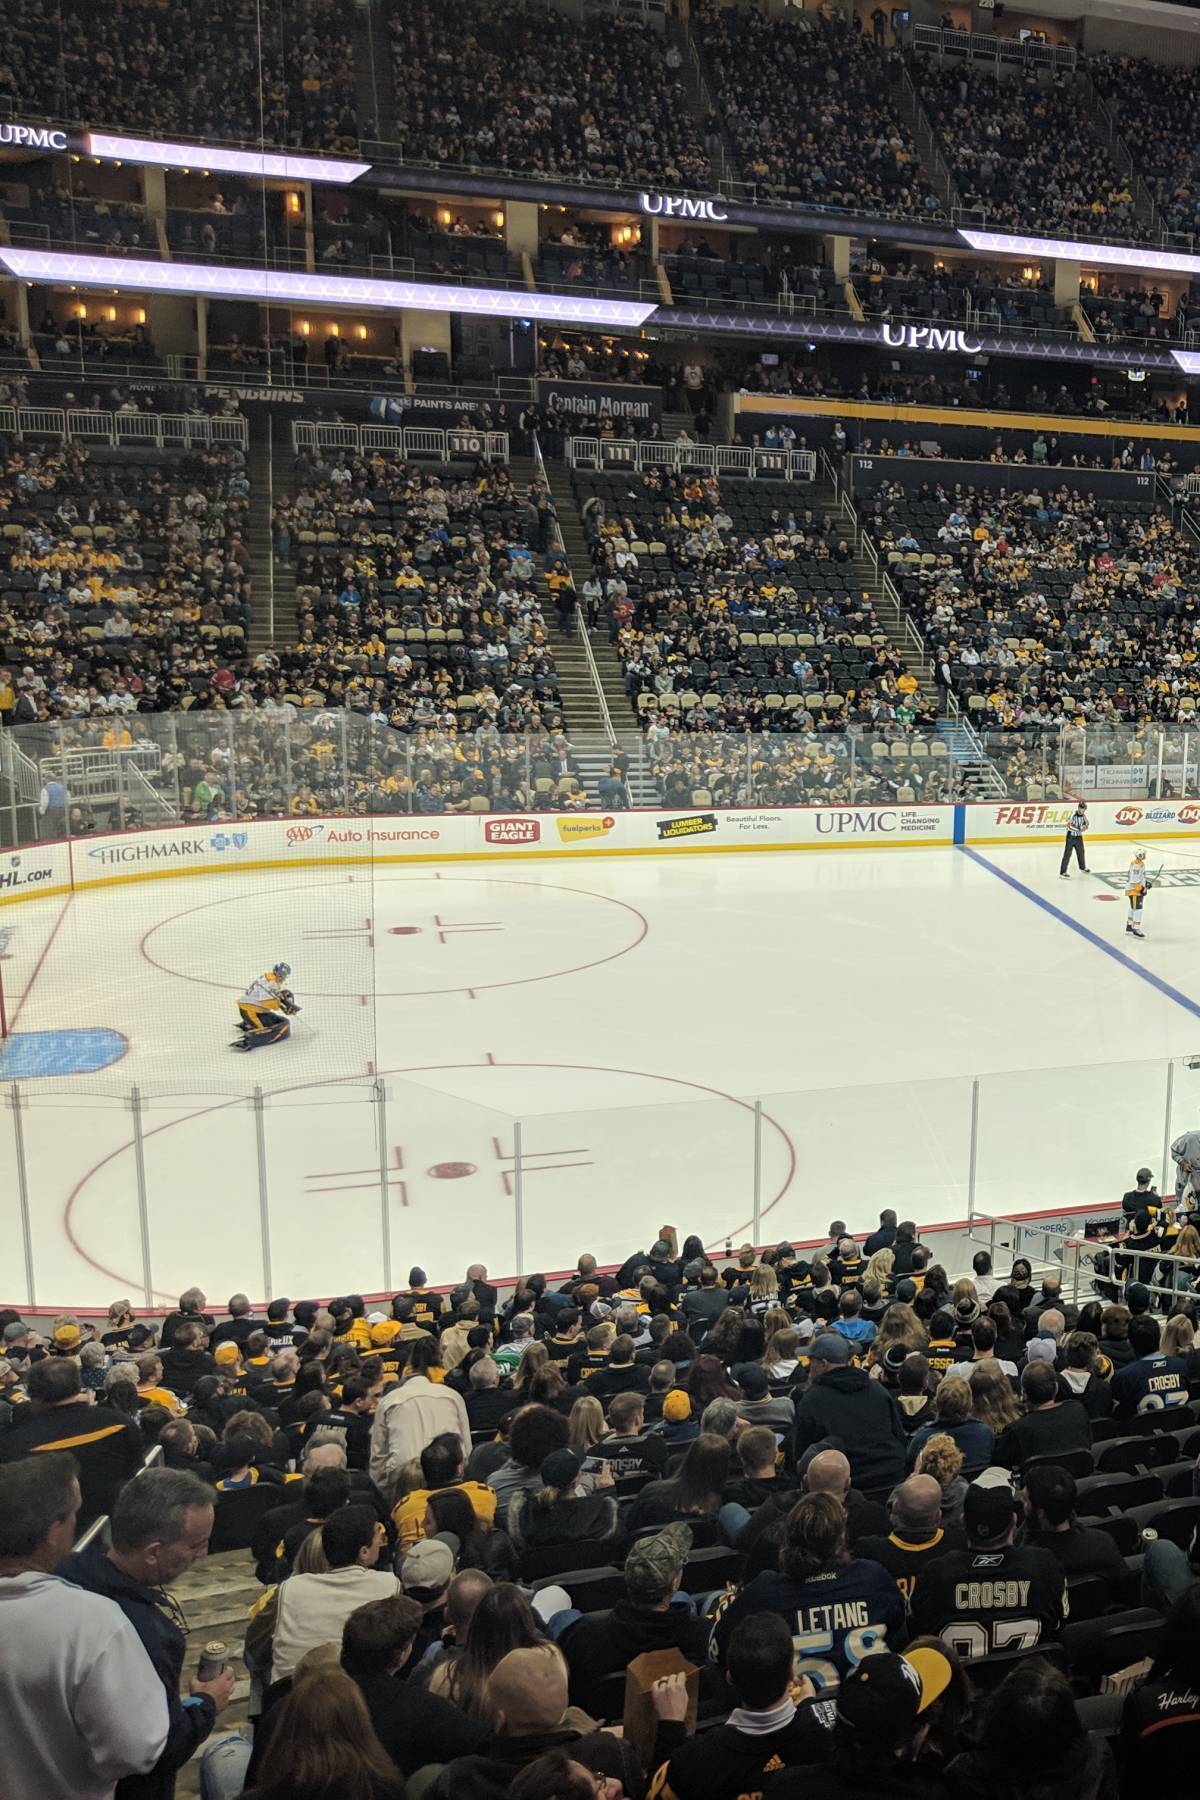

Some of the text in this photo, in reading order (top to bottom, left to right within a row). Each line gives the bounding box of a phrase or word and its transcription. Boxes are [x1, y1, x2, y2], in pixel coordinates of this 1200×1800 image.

[0, 124, 68, 150] UPMC
[643, 193, 729, 221] UPMC
[882, 324, 982, 353] UPMC
[413, 400, 451, 410] PAINTS
[453, 438, 480, 452] 110
[608, 447, 630, 460] 111
[761, 456, 782, 468] 111
[858, 460, 873, 470] 112
[1136, 477, 1150, 486] 112
[726, 815, 757, 823] Beautiful
[995, 806, 1071, 825] FAST PLA
[1119, 810, 1140, 822] DQ
[1145, 811, 1176, 820] BLIZZARD
[1182, 808, 1200, 820] DQ
[489, 822, 536, 832] GIANT
[671, 818, 704, 828] LUMBER
[815, 811, 897, 833] UPMC
[901, 817, 940, 825] CHANGING
[563, 823, 601, 833] fuelperks
[663, 823, 714, 838] LIQUIDATORS
[327, 827, 440, 843] Auto Insurance
[491, 831, 535, 840] EAGLE
[100, 838, 205, 865] HIGHMARK
[1148, 1373, 1180, 1392] CROSBY
[955, 1580, 1031, 1610] CROSBY
[797, 1601, 870, 1634] LETANG
